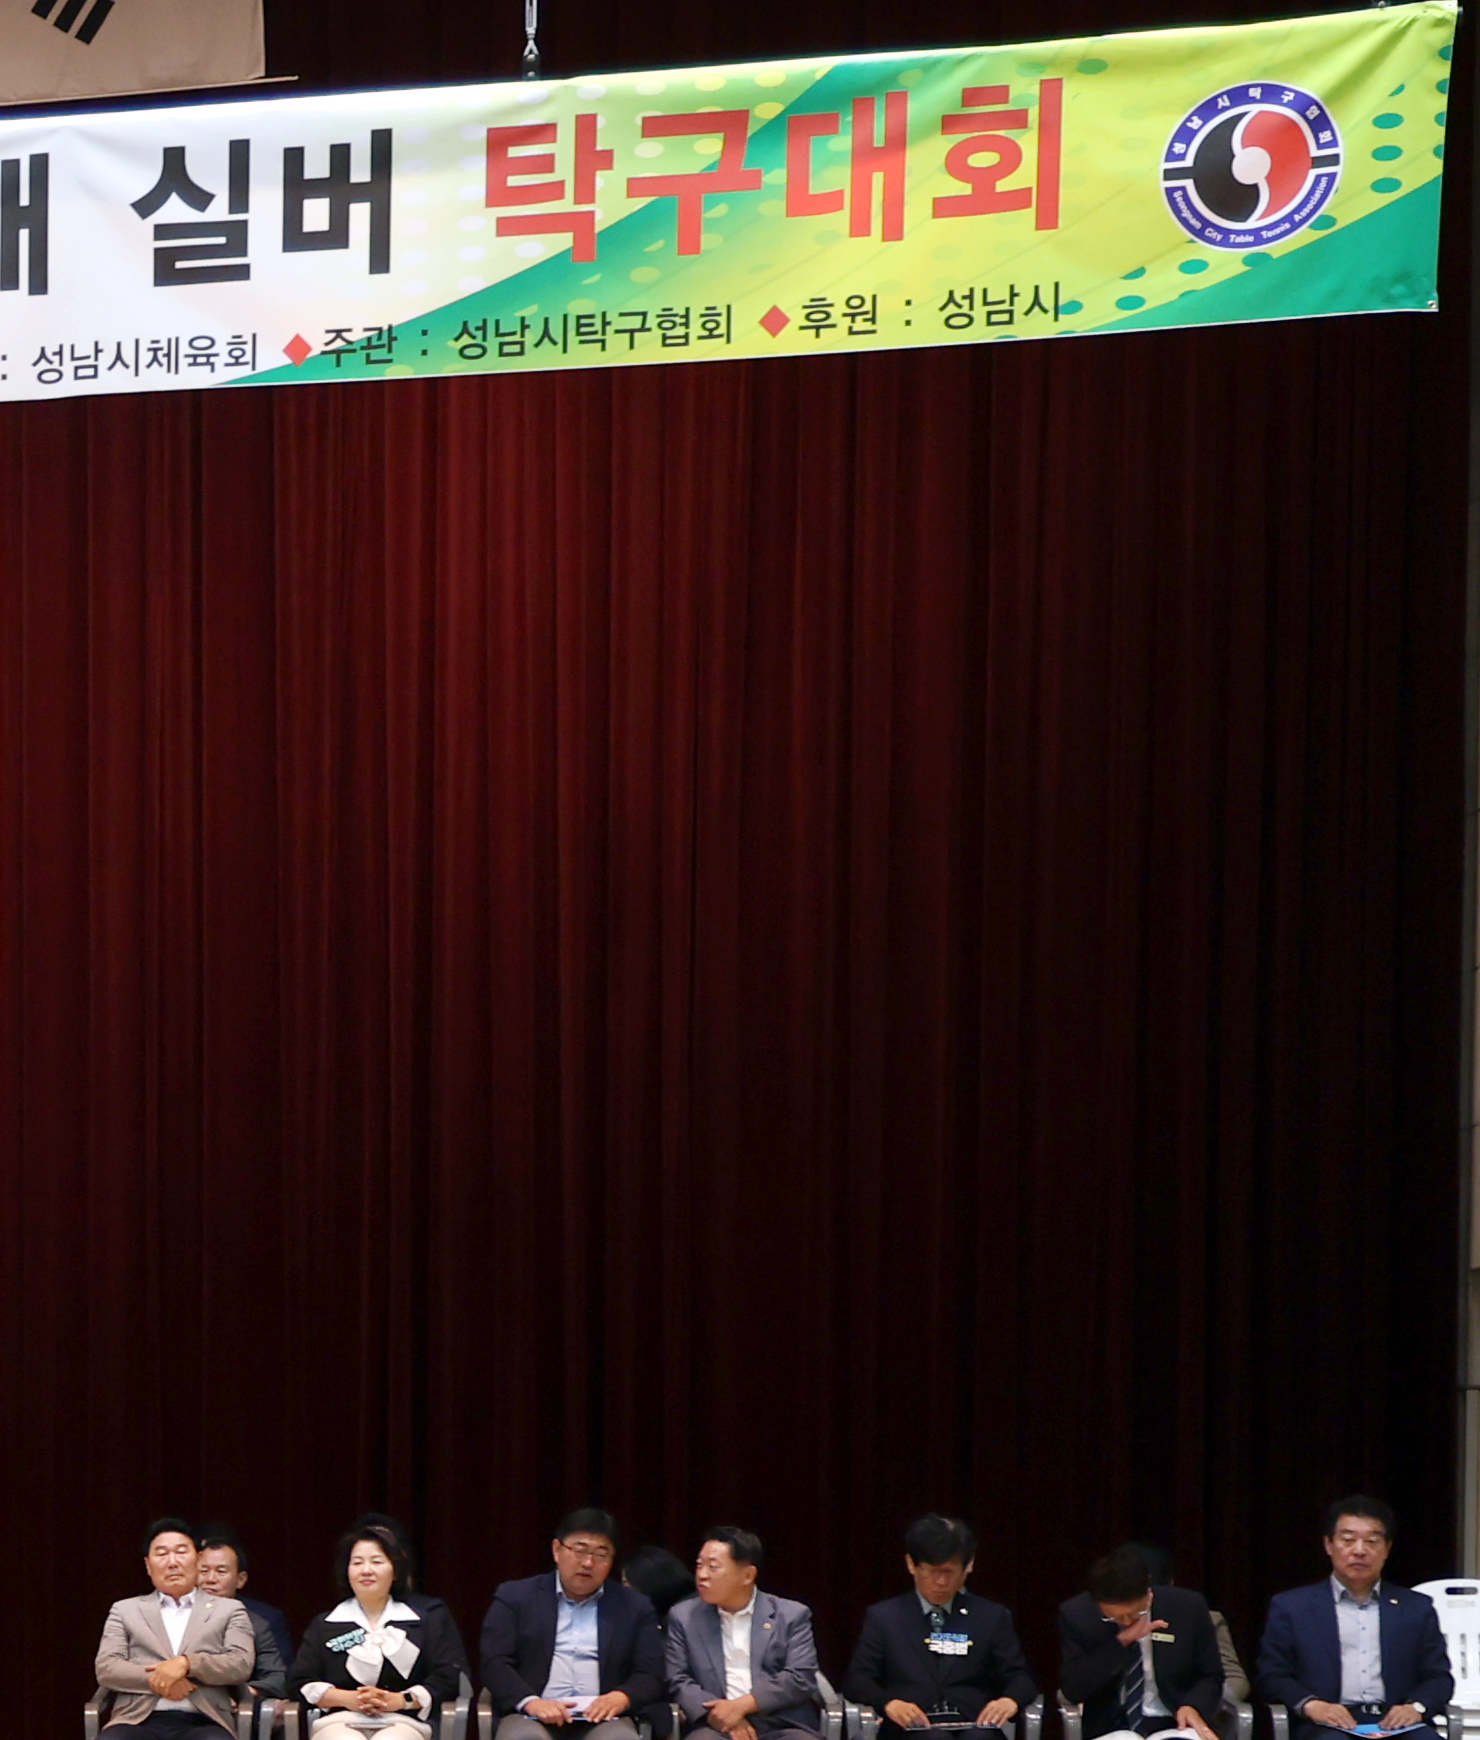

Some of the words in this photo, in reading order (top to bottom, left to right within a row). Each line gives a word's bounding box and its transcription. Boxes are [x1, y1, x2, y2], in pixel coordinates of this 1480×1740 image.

[130, 127, 393, 288] 실버
[485, 77, 1064, 264] 탁구대회
[1205, 227, 1223, 243] City
[1229, 233, 1255, 244] Table
[1261, 222, 1291, 239] Tennis
[1293, 176, 1329, 222] Association
[31, 332, 259, 385] 성남시체육회
[320, 324, 397, 368] 주관
[451, 303, 734, 361] 성남시탁구협회
[797, 292, 880, 338] 후원
[937, 280, 1063, 332] 성남시
